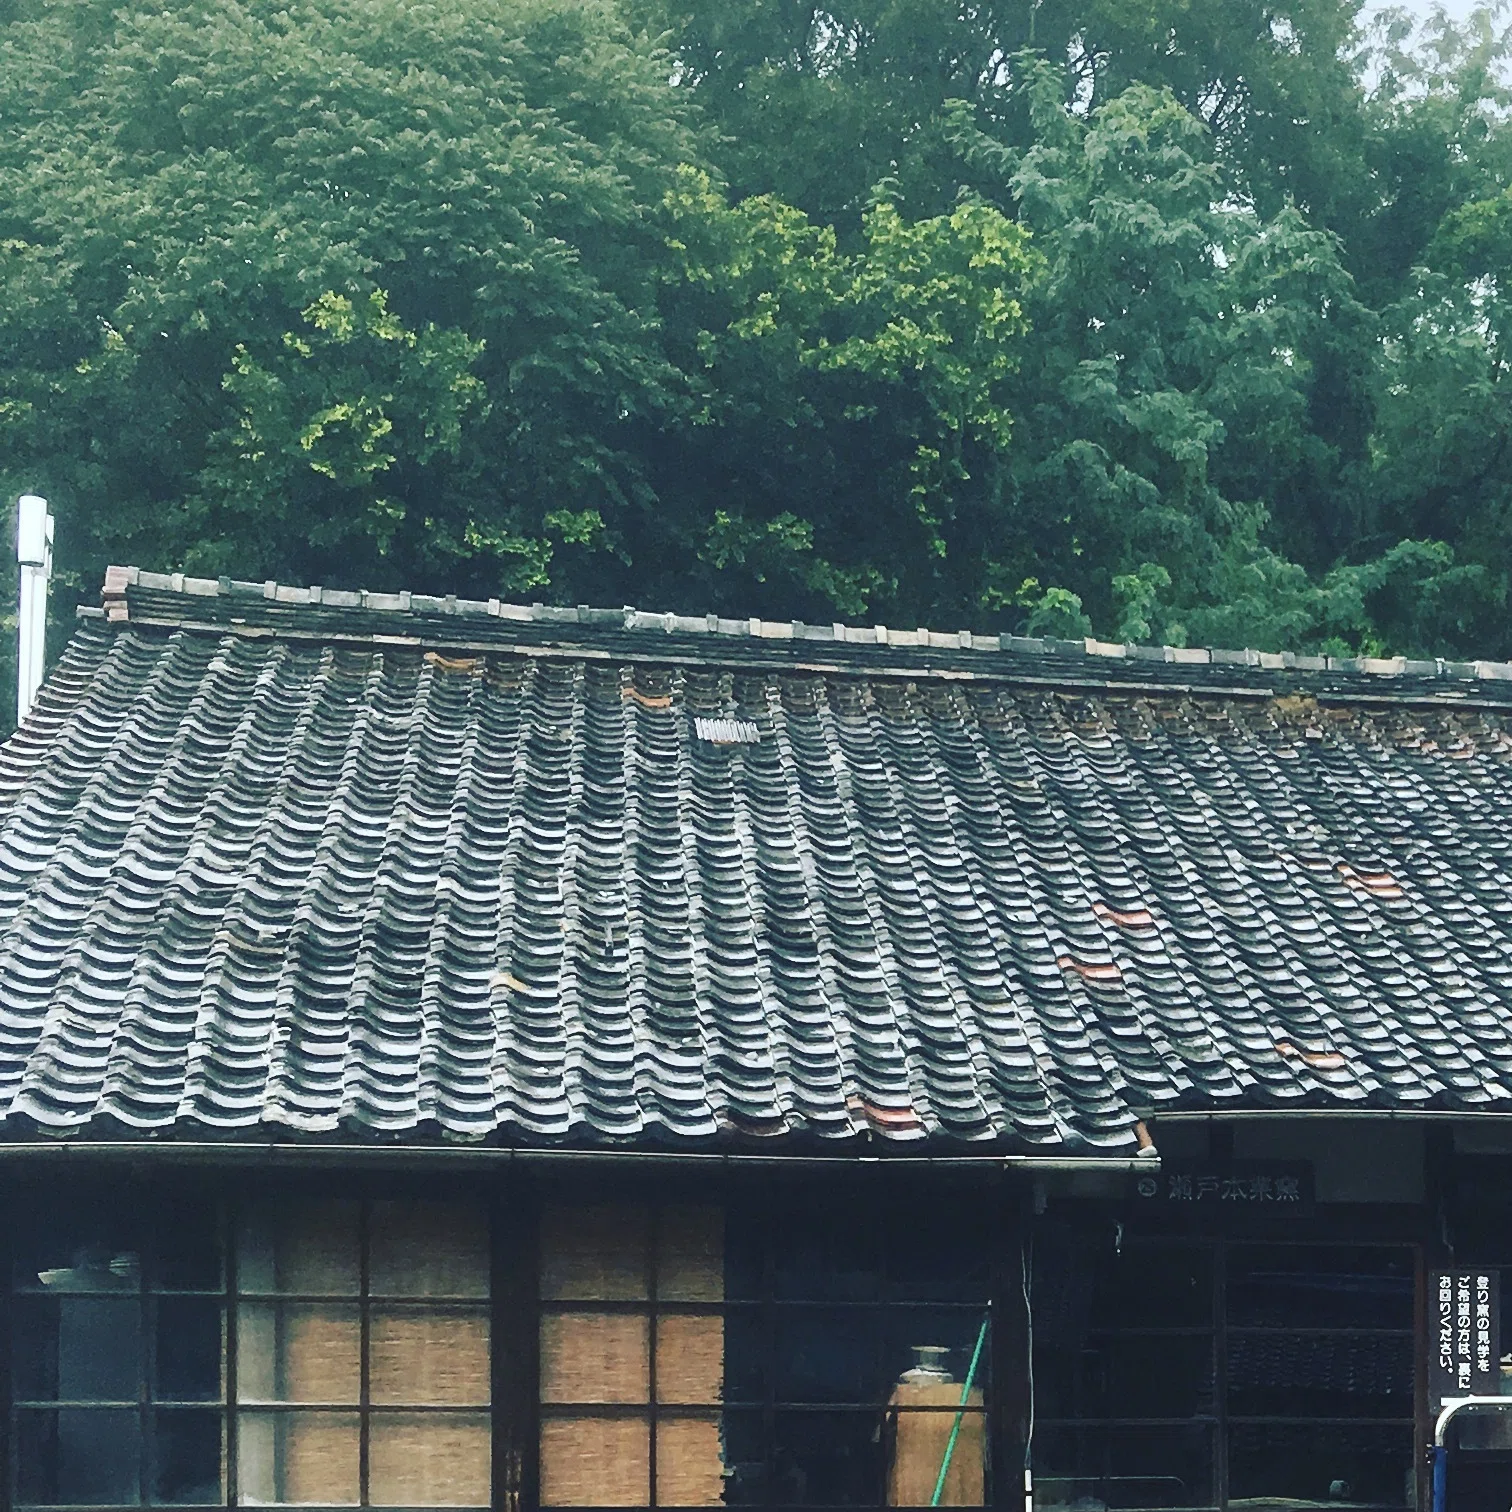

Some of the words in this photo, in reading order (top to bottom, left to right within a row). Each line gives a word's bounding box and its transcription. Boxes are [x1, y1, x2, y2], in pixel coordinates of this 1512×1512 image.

[1168, 1175, 1300, 1201] 瀬戸本業窯
[1439, 1275, 1453, 1374] お回りください。
[1477, 1275, 1491, 1372] 登り窯の見学を
